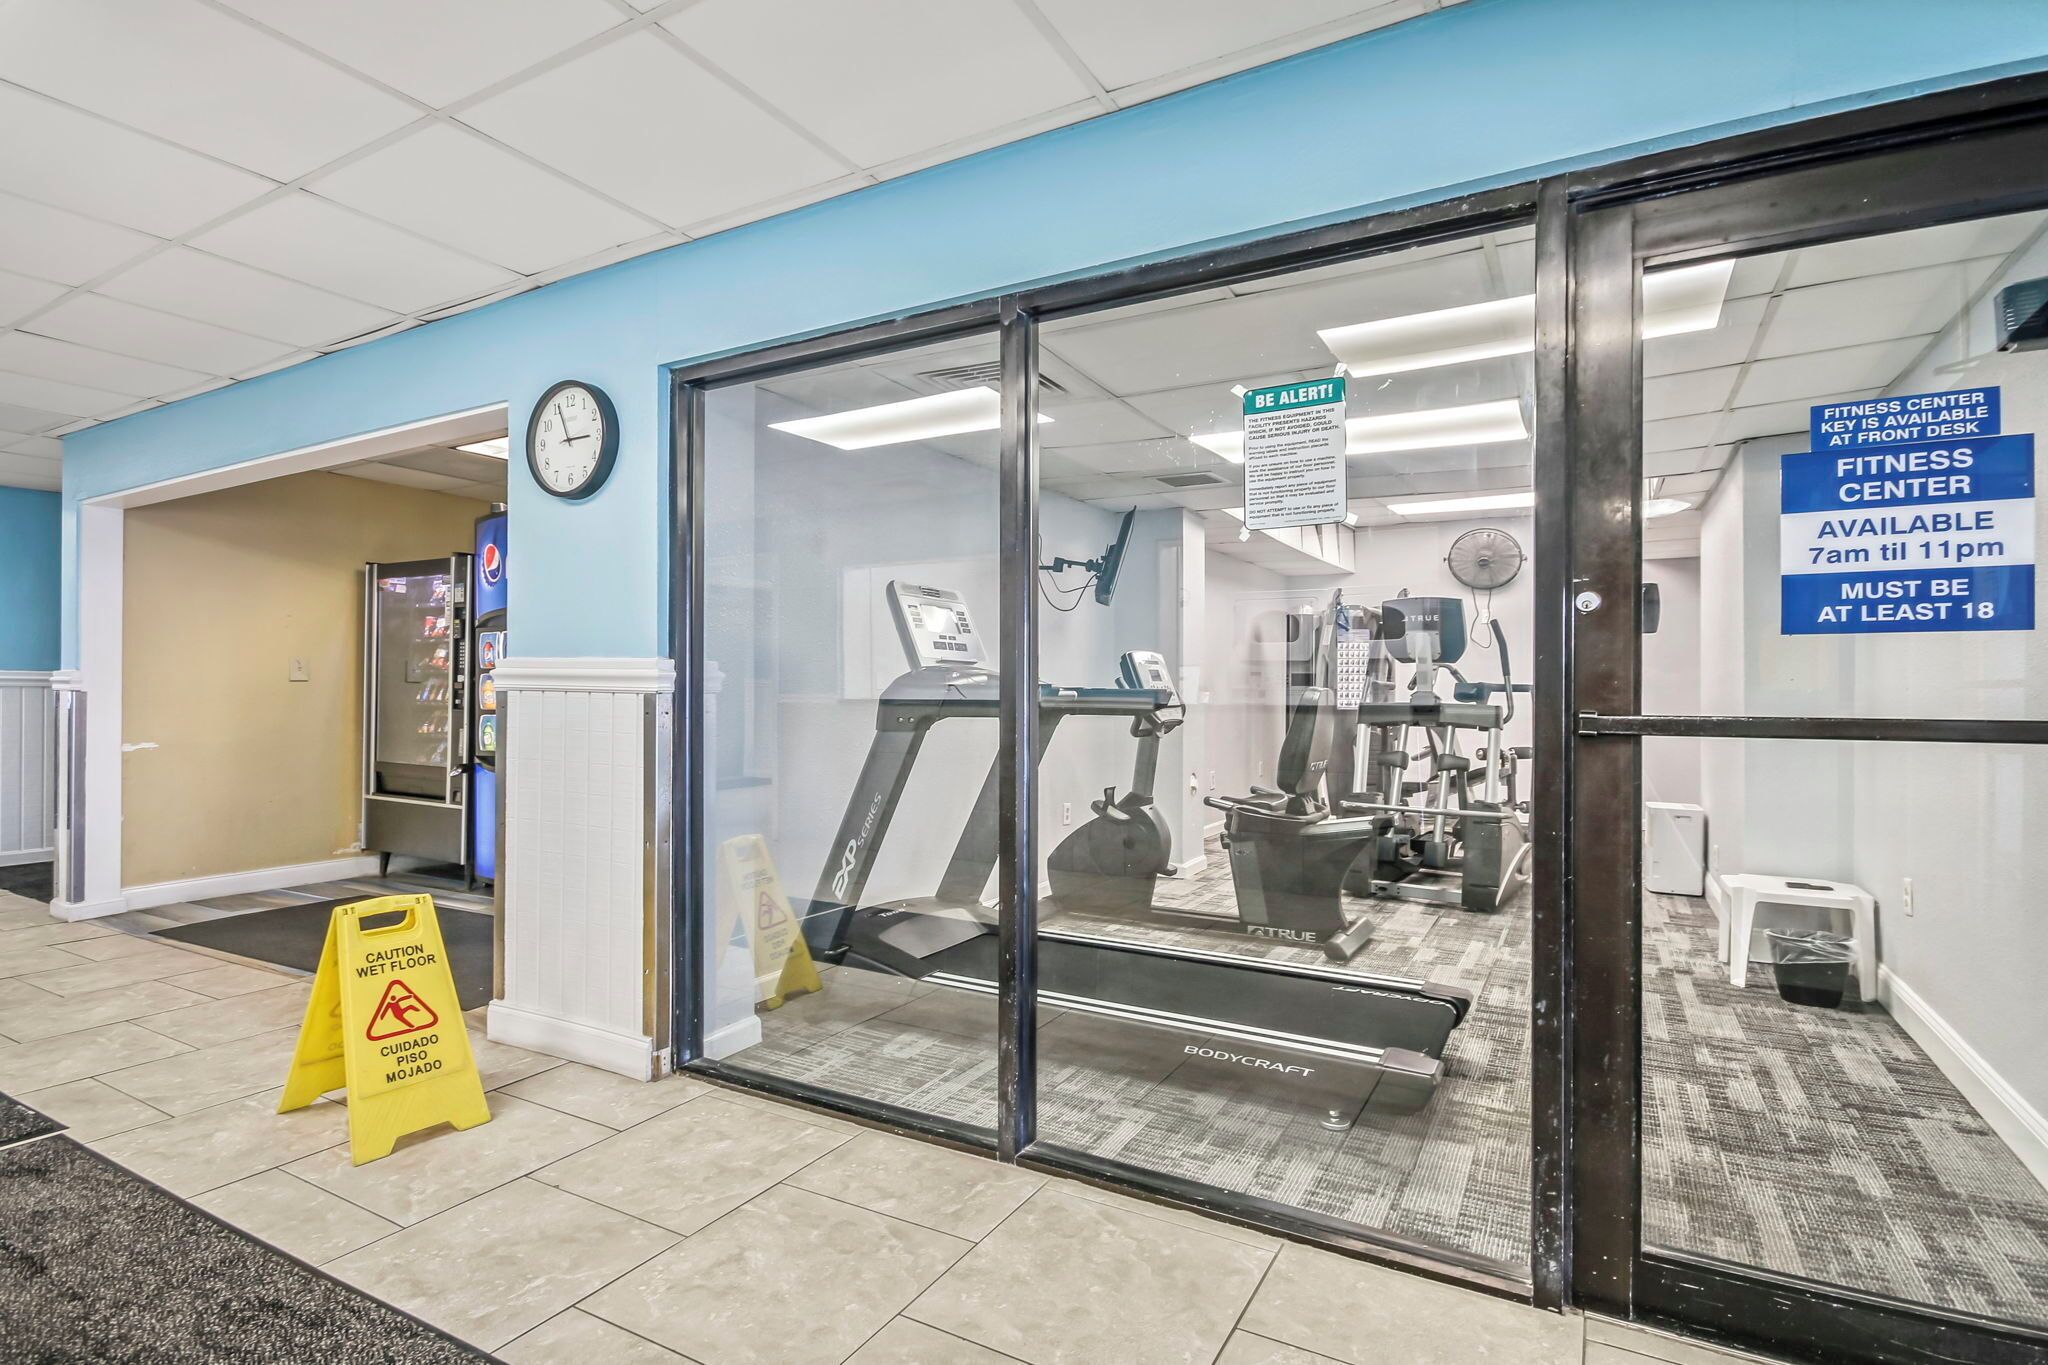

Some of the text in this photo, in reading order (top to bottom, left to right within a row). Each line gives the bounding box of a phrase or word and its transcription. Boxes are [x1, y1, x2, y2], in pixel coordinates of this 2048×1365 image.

[566, 394, 575, 408] 12
[582, 398, 586, 410] 1
[1256, 384, 1333, 408] BE ALERT!
[1824, 392, 1984, 419] FITNESS CENTER
[592, 408, 597, 421] 2
[1821, 406, 1989, 433] KEY IS AVAILABLE
[544, 420, 552, 432] 10
[1830, 421, 1980, 446] AT FRONT DESK
[541, 439, 545, 451] 9
[545, 458, 549, 470] 8
[1837, 448, 1973, 477] FITNESS
[554, 470, 559, 483] 7
[568, 473, 573, 485] 6
[1839, 475, 1971, 502] CENTER
[1817, 511, 1994, 539] AVAILABLE
[1808, 541, 2004, 564] 7am til 11pm
[1841, 579, 1970, 600] MUST BE
[1410, 614, 1440, 622] TRUE
[1817, 602, 1994, 623] AT LEAST 18
[857, 792, 882, 848] SERIES
[832, 839, 857, 900] EXP
[1265, 927, 1316, 943] TRUE
[366, 944, 424, 963] CAUTION
[356, 954, 436, 978] WET FLOOR
[380, 1034, 439, 1057] CUIDADO
[397, 1050, 427, 1066] PISO
[1183, 1045, 1315, 1077] BODYCRAFT
[386, 1060, 442, 1083] MOJADO
